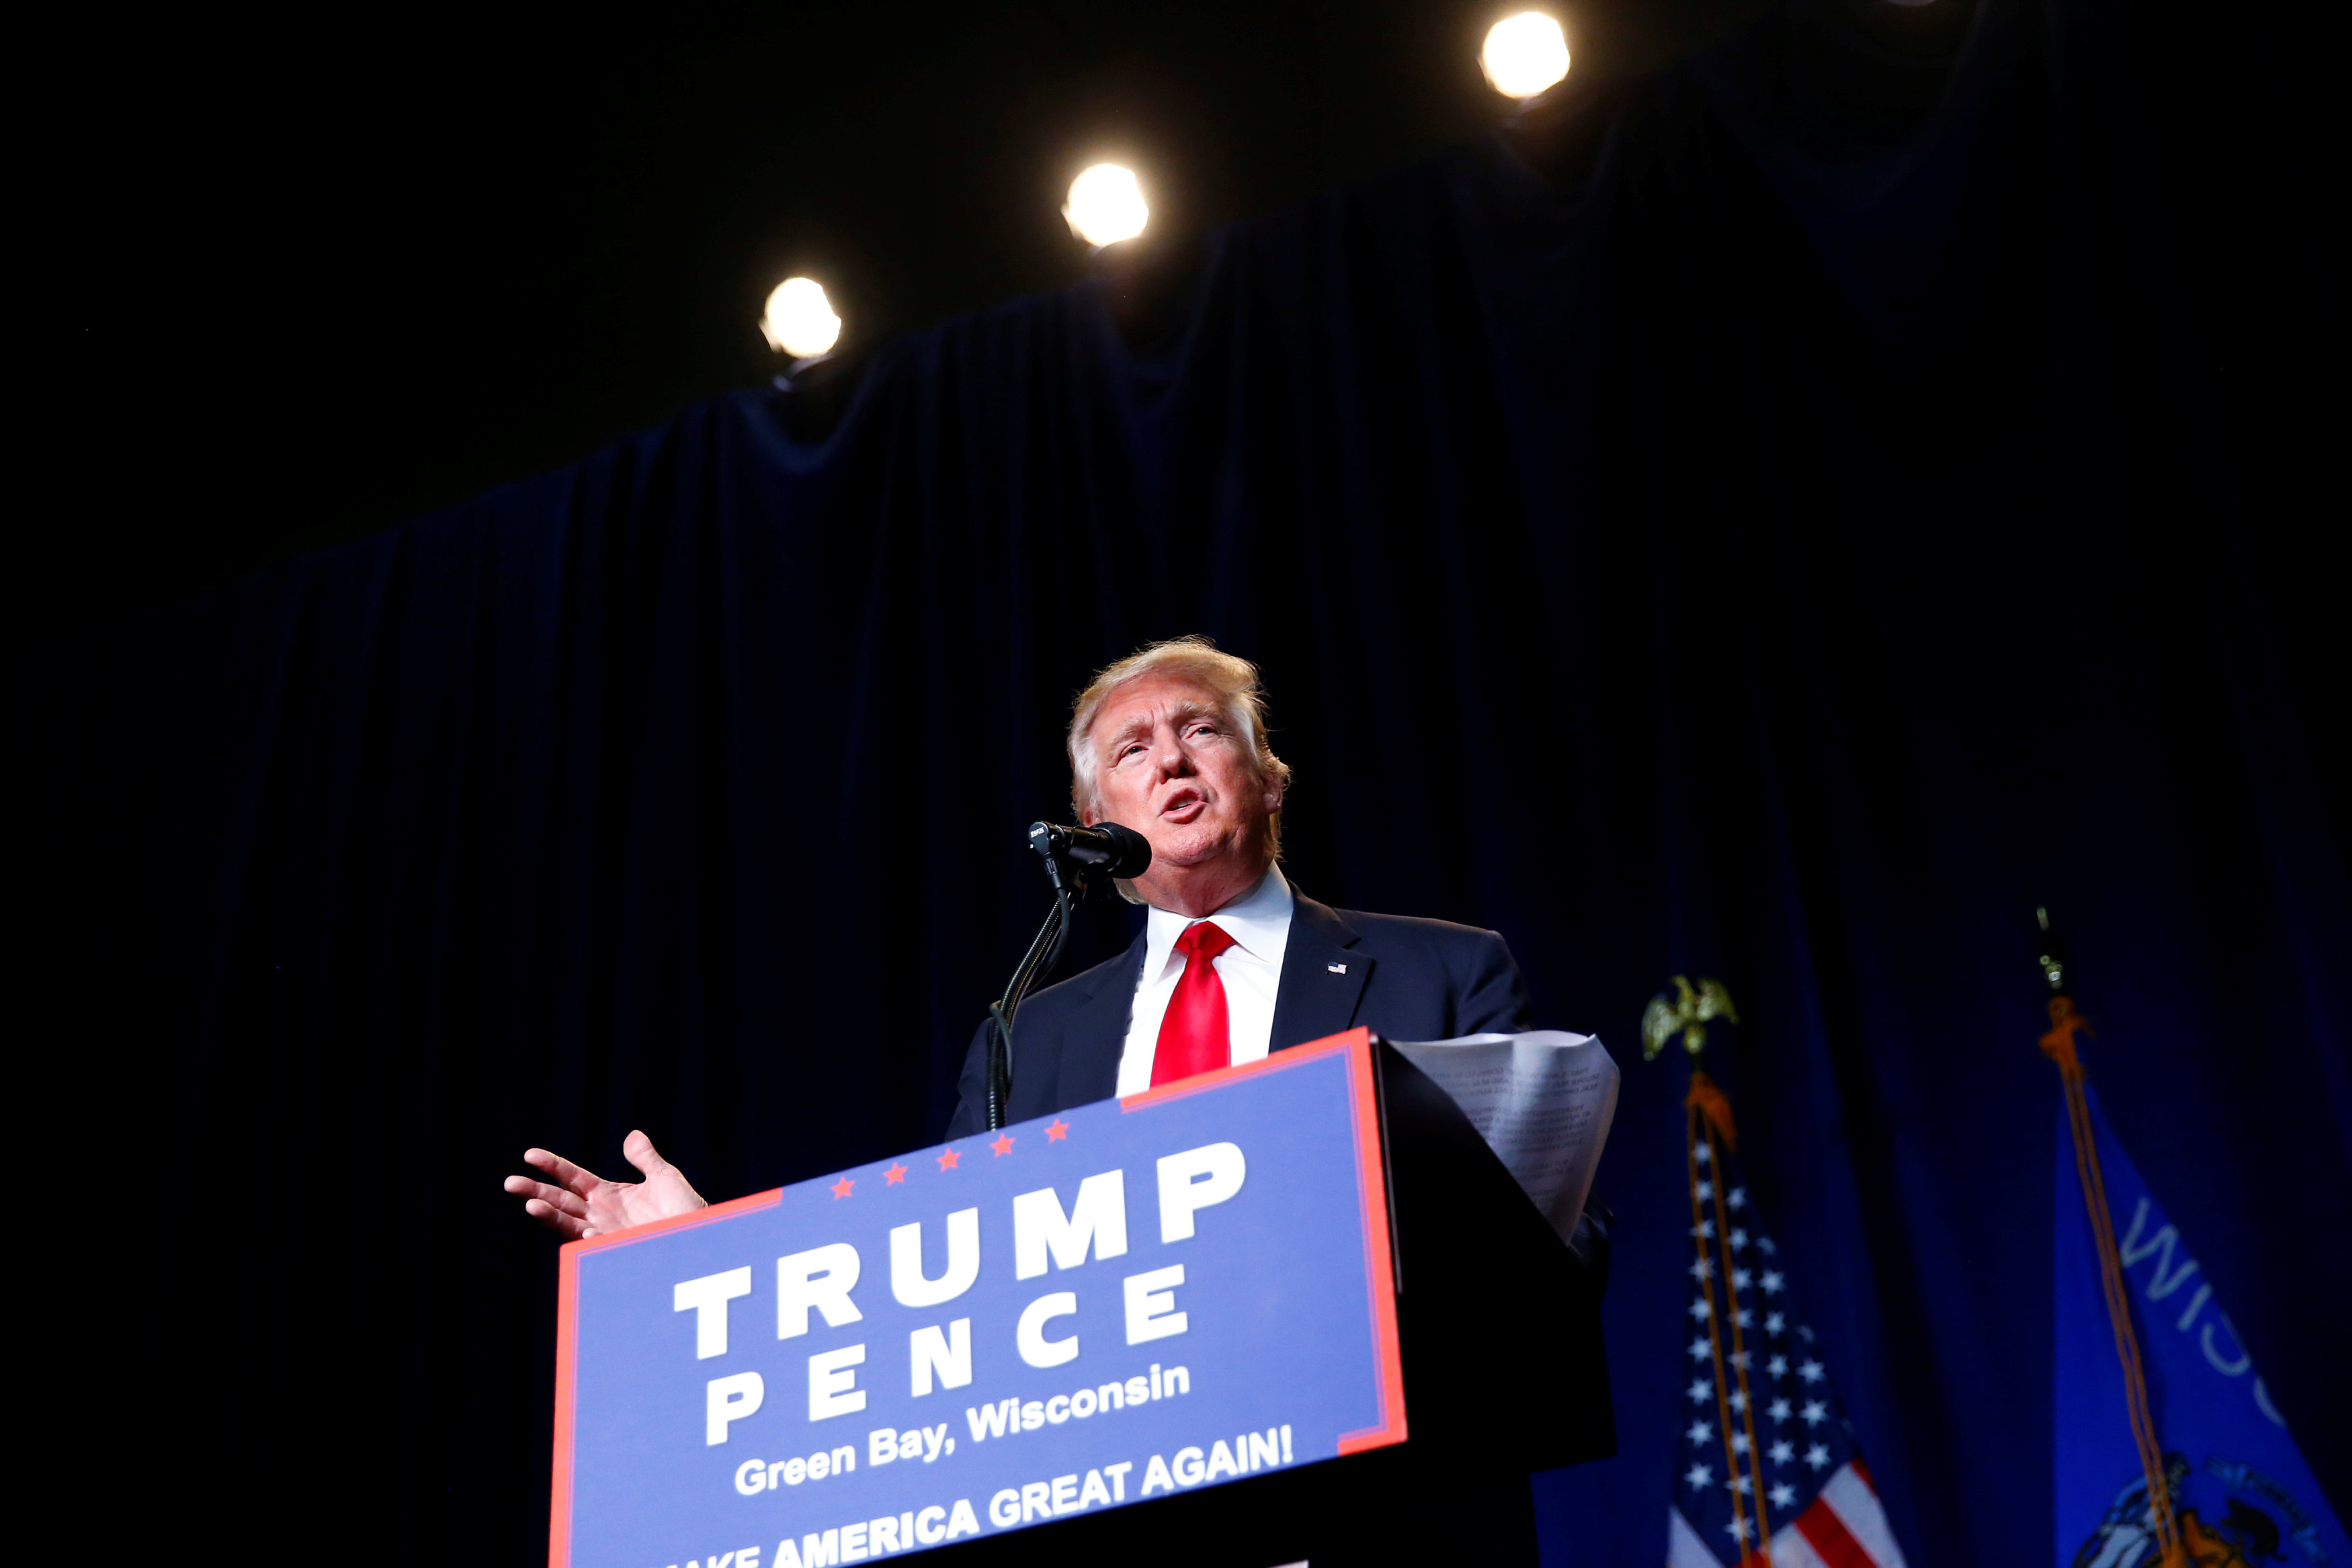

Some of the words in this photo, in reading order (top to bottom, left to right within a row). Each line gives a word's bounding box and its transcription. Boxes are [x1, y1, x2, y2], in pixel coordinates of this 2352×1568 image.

[673, 1141, 1247, 1360] TRUMP
[706, 1263, 1188, 1446] PENCE
[734, 1444, 856, 1496] Green
[868, 1422, 956, 1467] Bay,
[965, 1362, 1190, 1442] Wisconsin
[772, 1498, 980, 1568] AMERICA
[989, 1461, 1133, 1528] GREAT
[1140, 1424, 1294, 1496] AGAIN!
